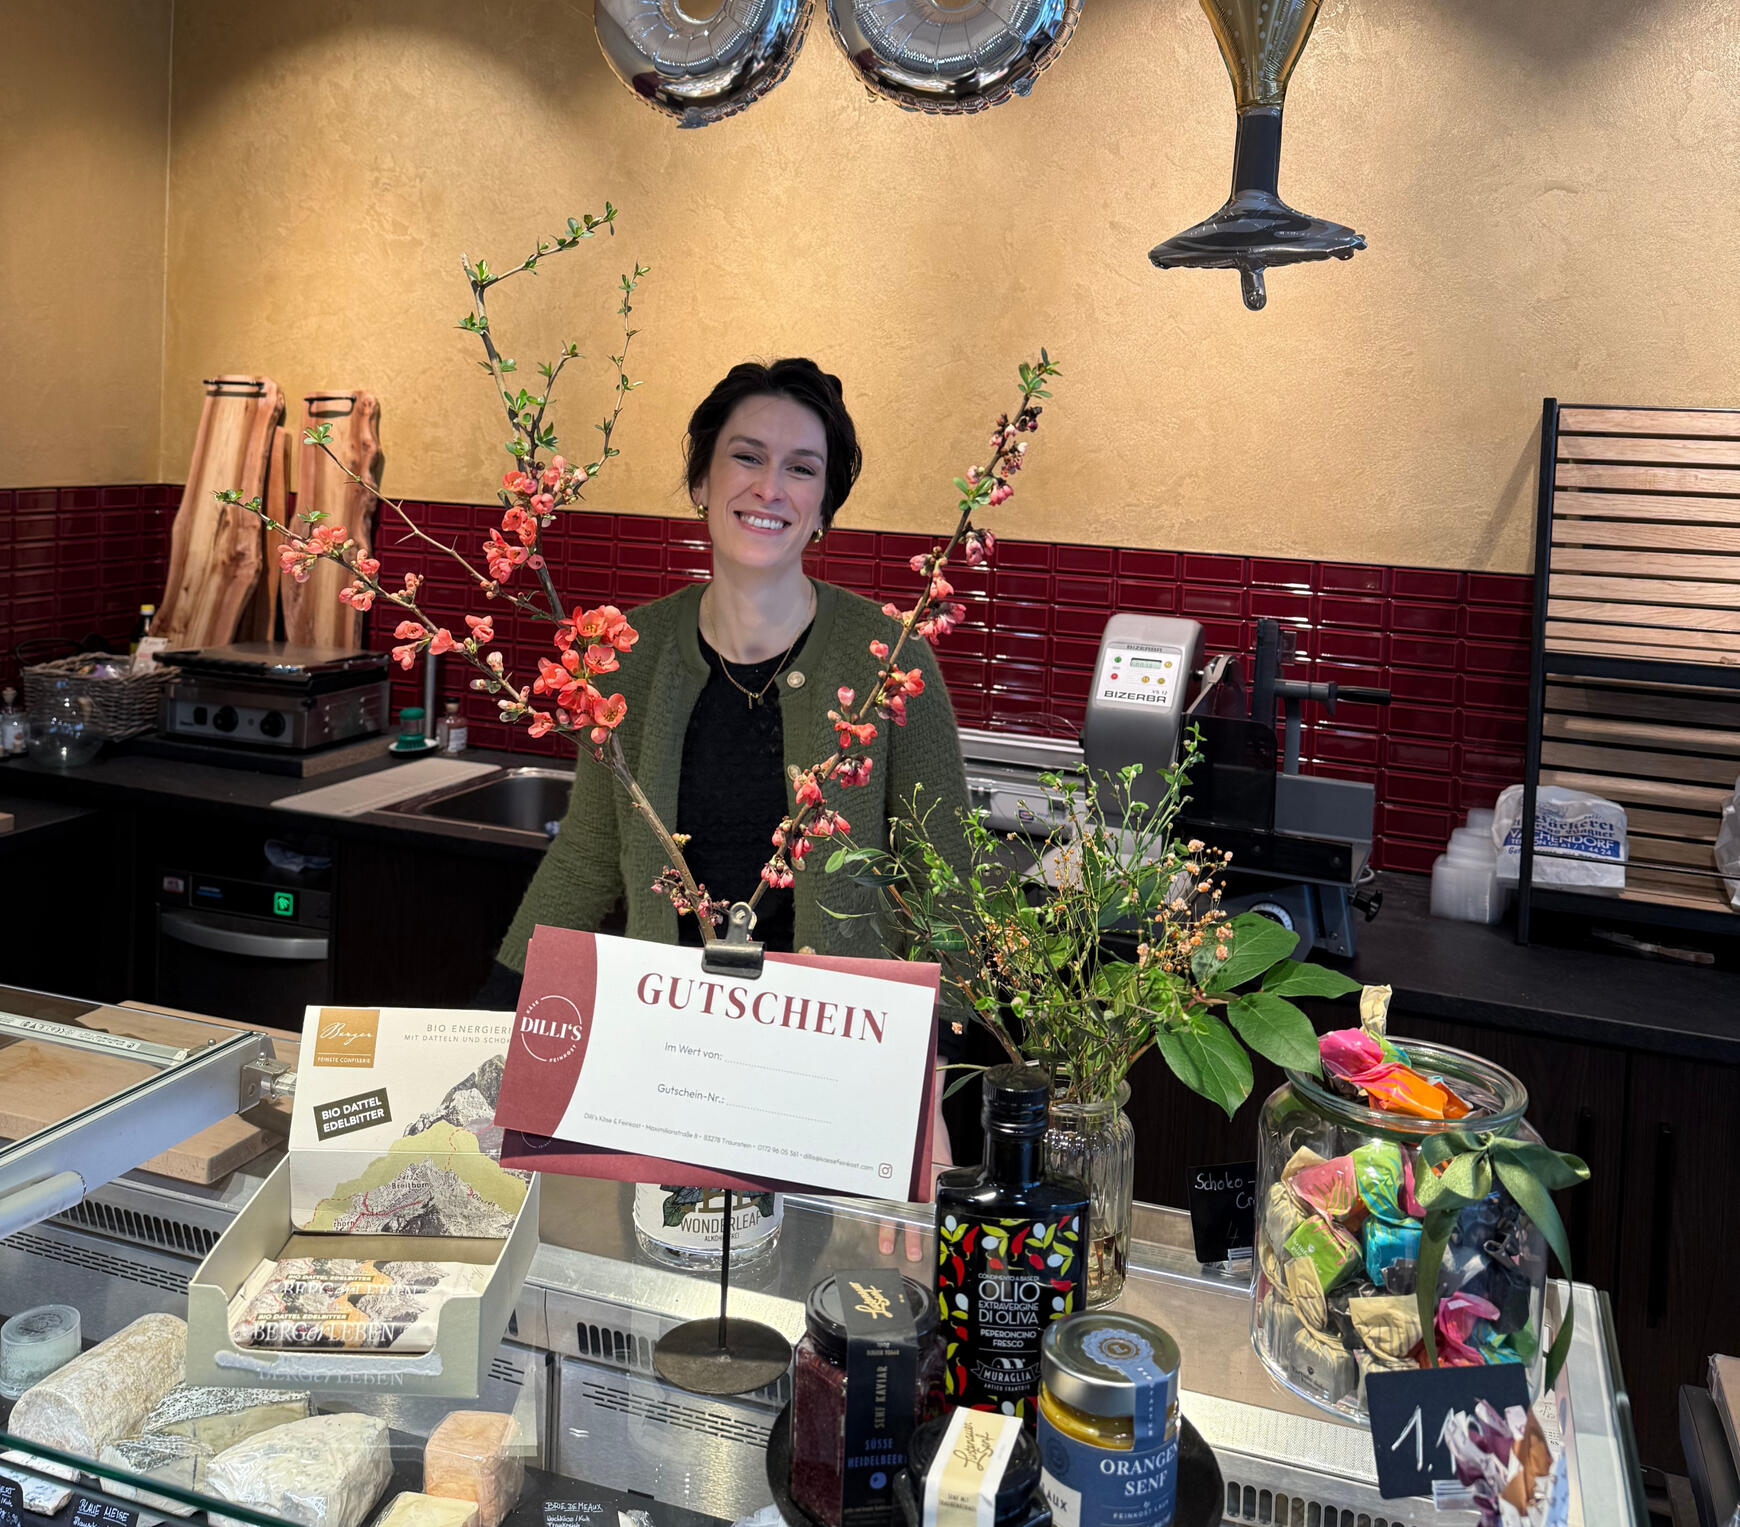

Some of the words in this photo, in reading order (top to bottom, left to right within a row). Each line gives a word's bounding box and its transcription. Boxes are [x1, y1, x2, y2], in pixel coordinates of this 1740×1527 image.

[1104, 690, 1167, 703] BIZERBA
[636, 972, 889, 1044] GUTSCHEIN
[426, 1023, 447, 1033] BIO
[520, 1016, 583, 1042] DILLI'S
[422, 1035, 459, 1043] DATTELN
[462, 1036, 480, 1044] UND
[664, 1042, 677, 1053] Im
[679, 1043, 701, 1056] Wert
[702, 1049, 723, 1061] von:
[321, 1106, 341, 1121] BIO
[342, 1096, 382, 1115] DATTEL
[322, 1109, 385, 1134] EDELBITTER
[978, 1280, 1040, 1303] OLIO
[979, 1299, 1039, 1312] EXTRAVERGINE
[979, 1309, 993, 1323] DI
[995, 1311, 1039, 1325] OLIVA
[980, 1328, 1037, 1339] PEPERONCINO
[993, 1339, 1024, 1348] FRESCO
[874, 1365, 889, 1402] KAVIAR
[983, 1370, 1032, 1383] MURAGLIA
[1124, 1470, 1168, 1497] SENF
